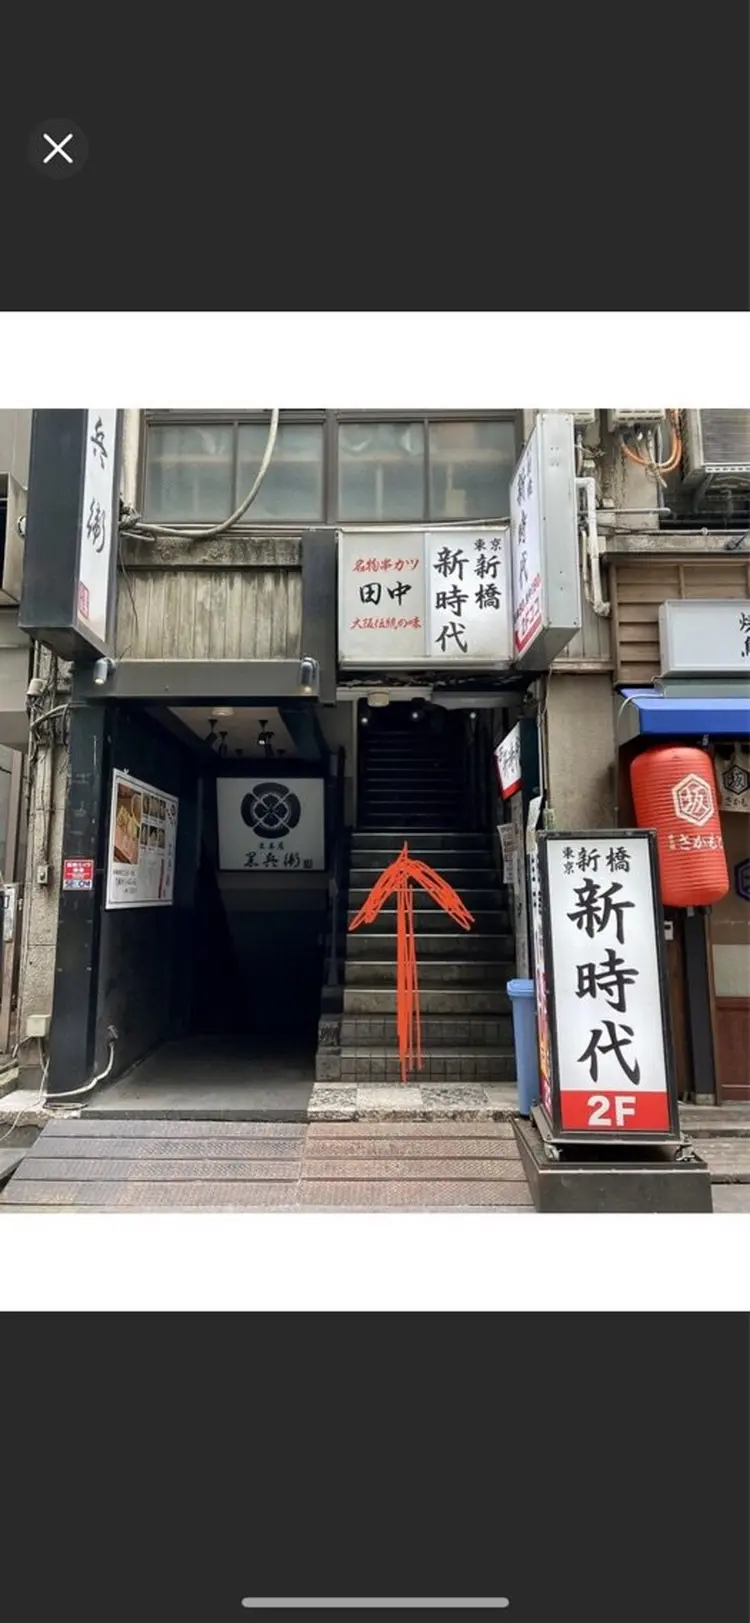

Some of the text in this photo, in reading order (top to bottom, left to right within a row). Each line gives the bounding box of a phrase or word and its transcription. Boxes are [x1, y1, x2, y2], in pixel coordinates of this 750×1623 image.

[473, 538, 502, 551] 東京
[359, 581, 412, 606] 田中
[473, 553, 502, 610] 新橋
[433, 546, 470, 653] 新時代
[562, 846, 574, 875] 東京
[576, 846, 632, 873] 新橋
[567, 878, 641, 1086] 新時代
[586, 1095, 637, 1127] 2F
